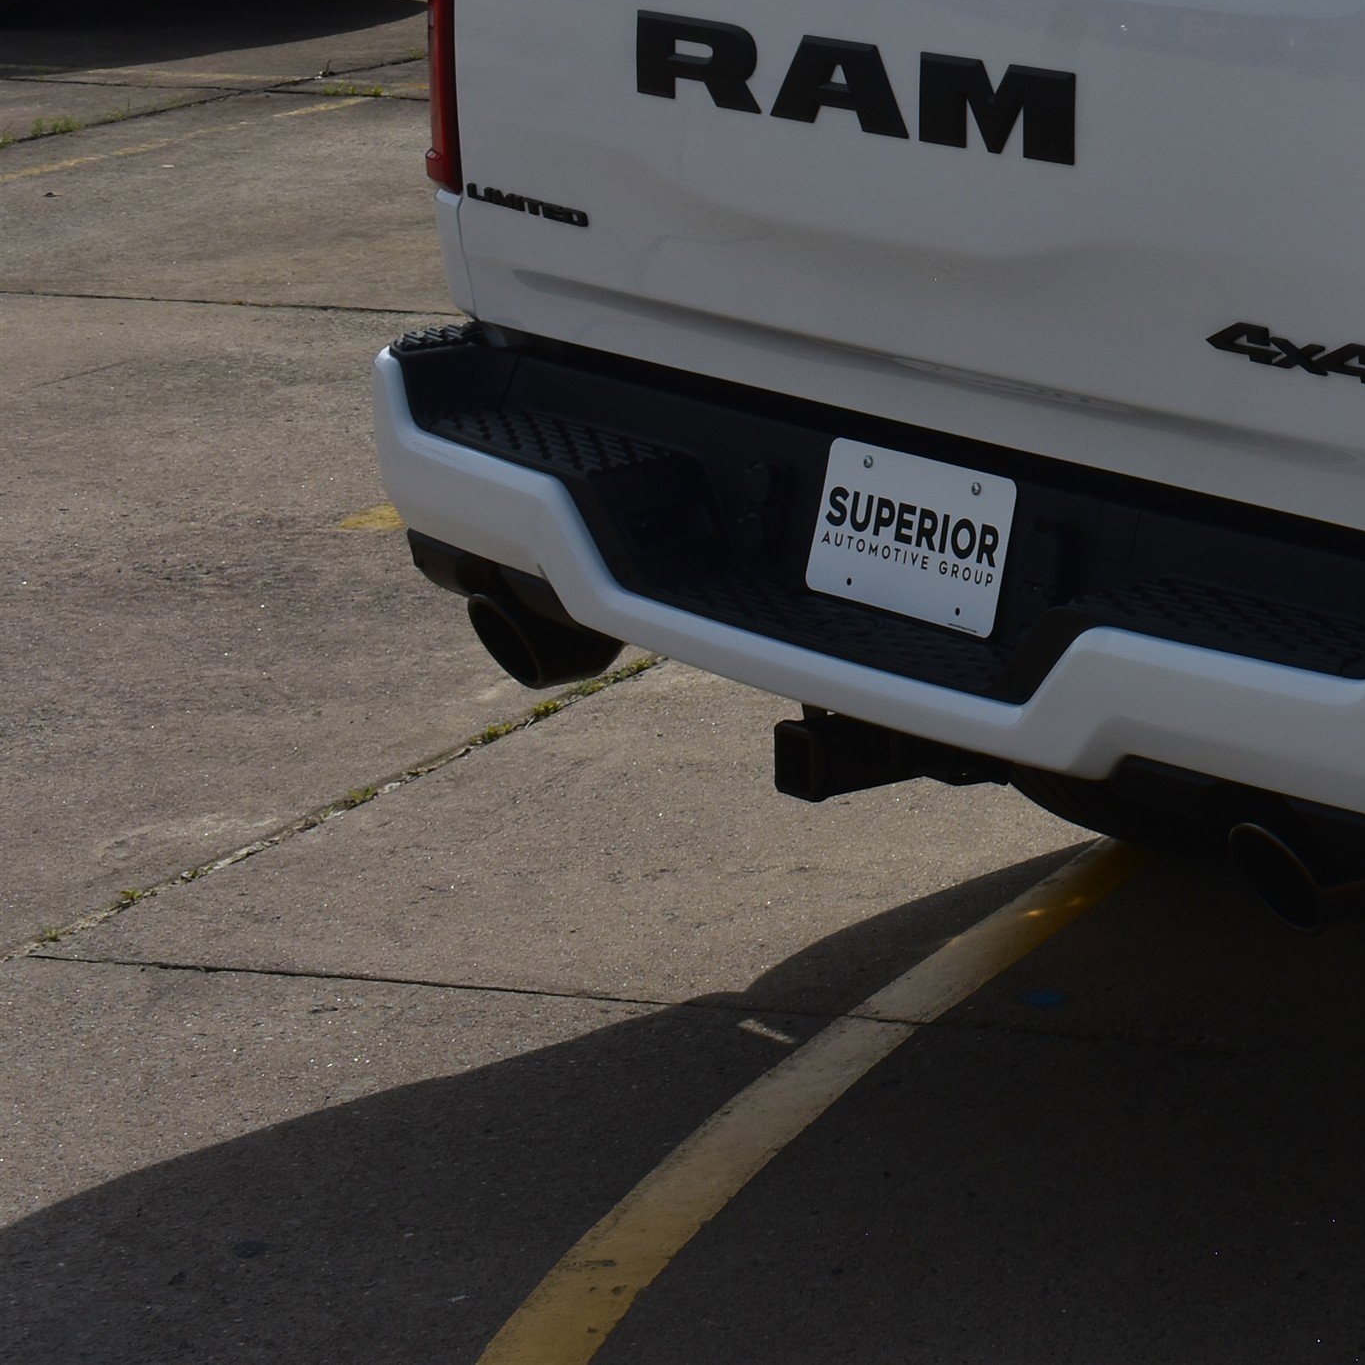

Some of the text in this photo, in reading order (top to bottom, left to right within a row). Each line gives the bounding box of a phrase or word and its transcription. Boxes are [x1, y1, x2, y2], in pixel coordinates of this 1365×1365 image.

[636, 9, 1076, 165] RAM
[466, 182, 589, 227] LIMITED
[821, 530, 994, 588] AUTOMOTIVE GROUP
[825, 486, 999, 568] SUPERIOR
